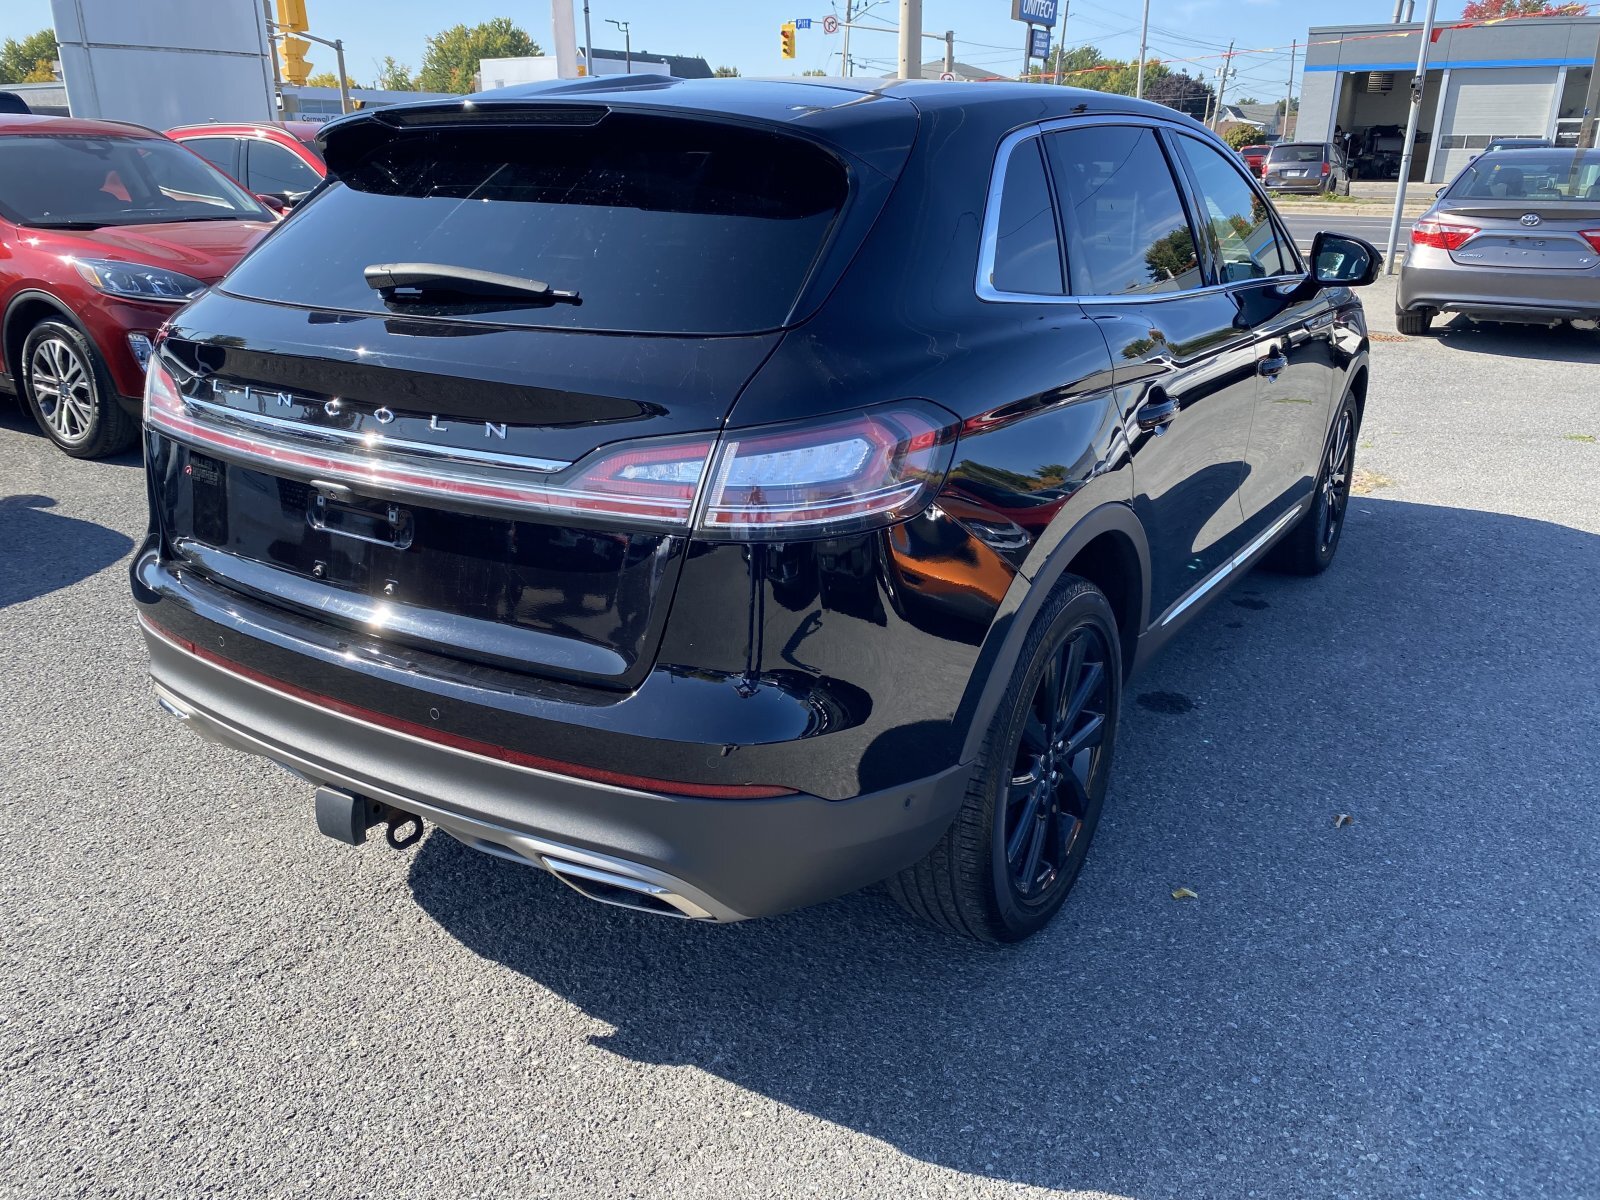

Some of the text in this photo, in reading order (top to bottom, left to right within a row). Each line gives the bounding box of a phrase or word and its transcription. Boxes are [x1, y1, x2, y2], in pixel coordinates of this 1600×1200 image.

[1023, 0, 1055, 19] UNITECH
[797, 19, 809, 28] Pitt
[212, 379, 507, 440] LINCOLN
